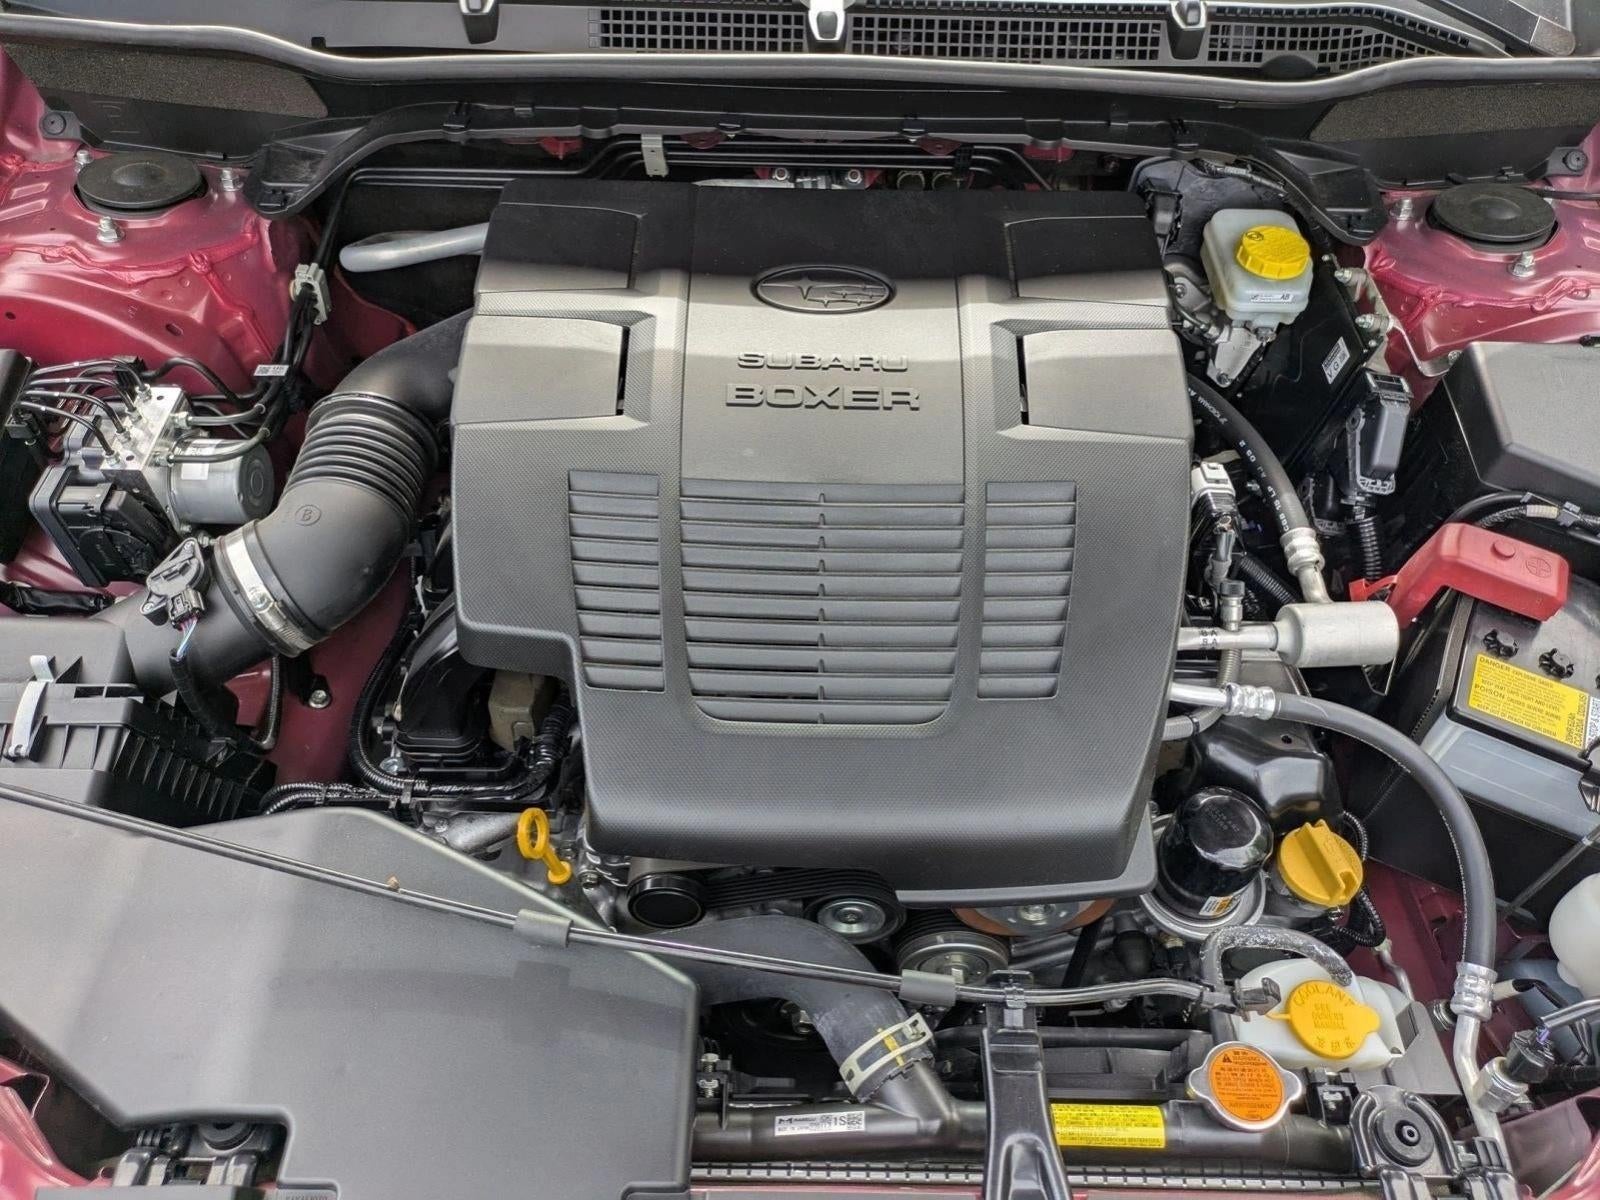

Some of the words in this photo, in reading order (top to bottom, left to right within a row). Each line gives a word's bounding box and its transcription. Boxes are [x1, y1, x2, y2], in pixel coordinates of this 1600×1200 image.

[738, 353, 908, 373] SUBARU
[726, 384, 920, 411] BOXER
[1479, 656, 1510, 671] DANGER
[1474, 683, 1504, 699] POISON
[1293, 982, 1356, 1007] COOLANT
